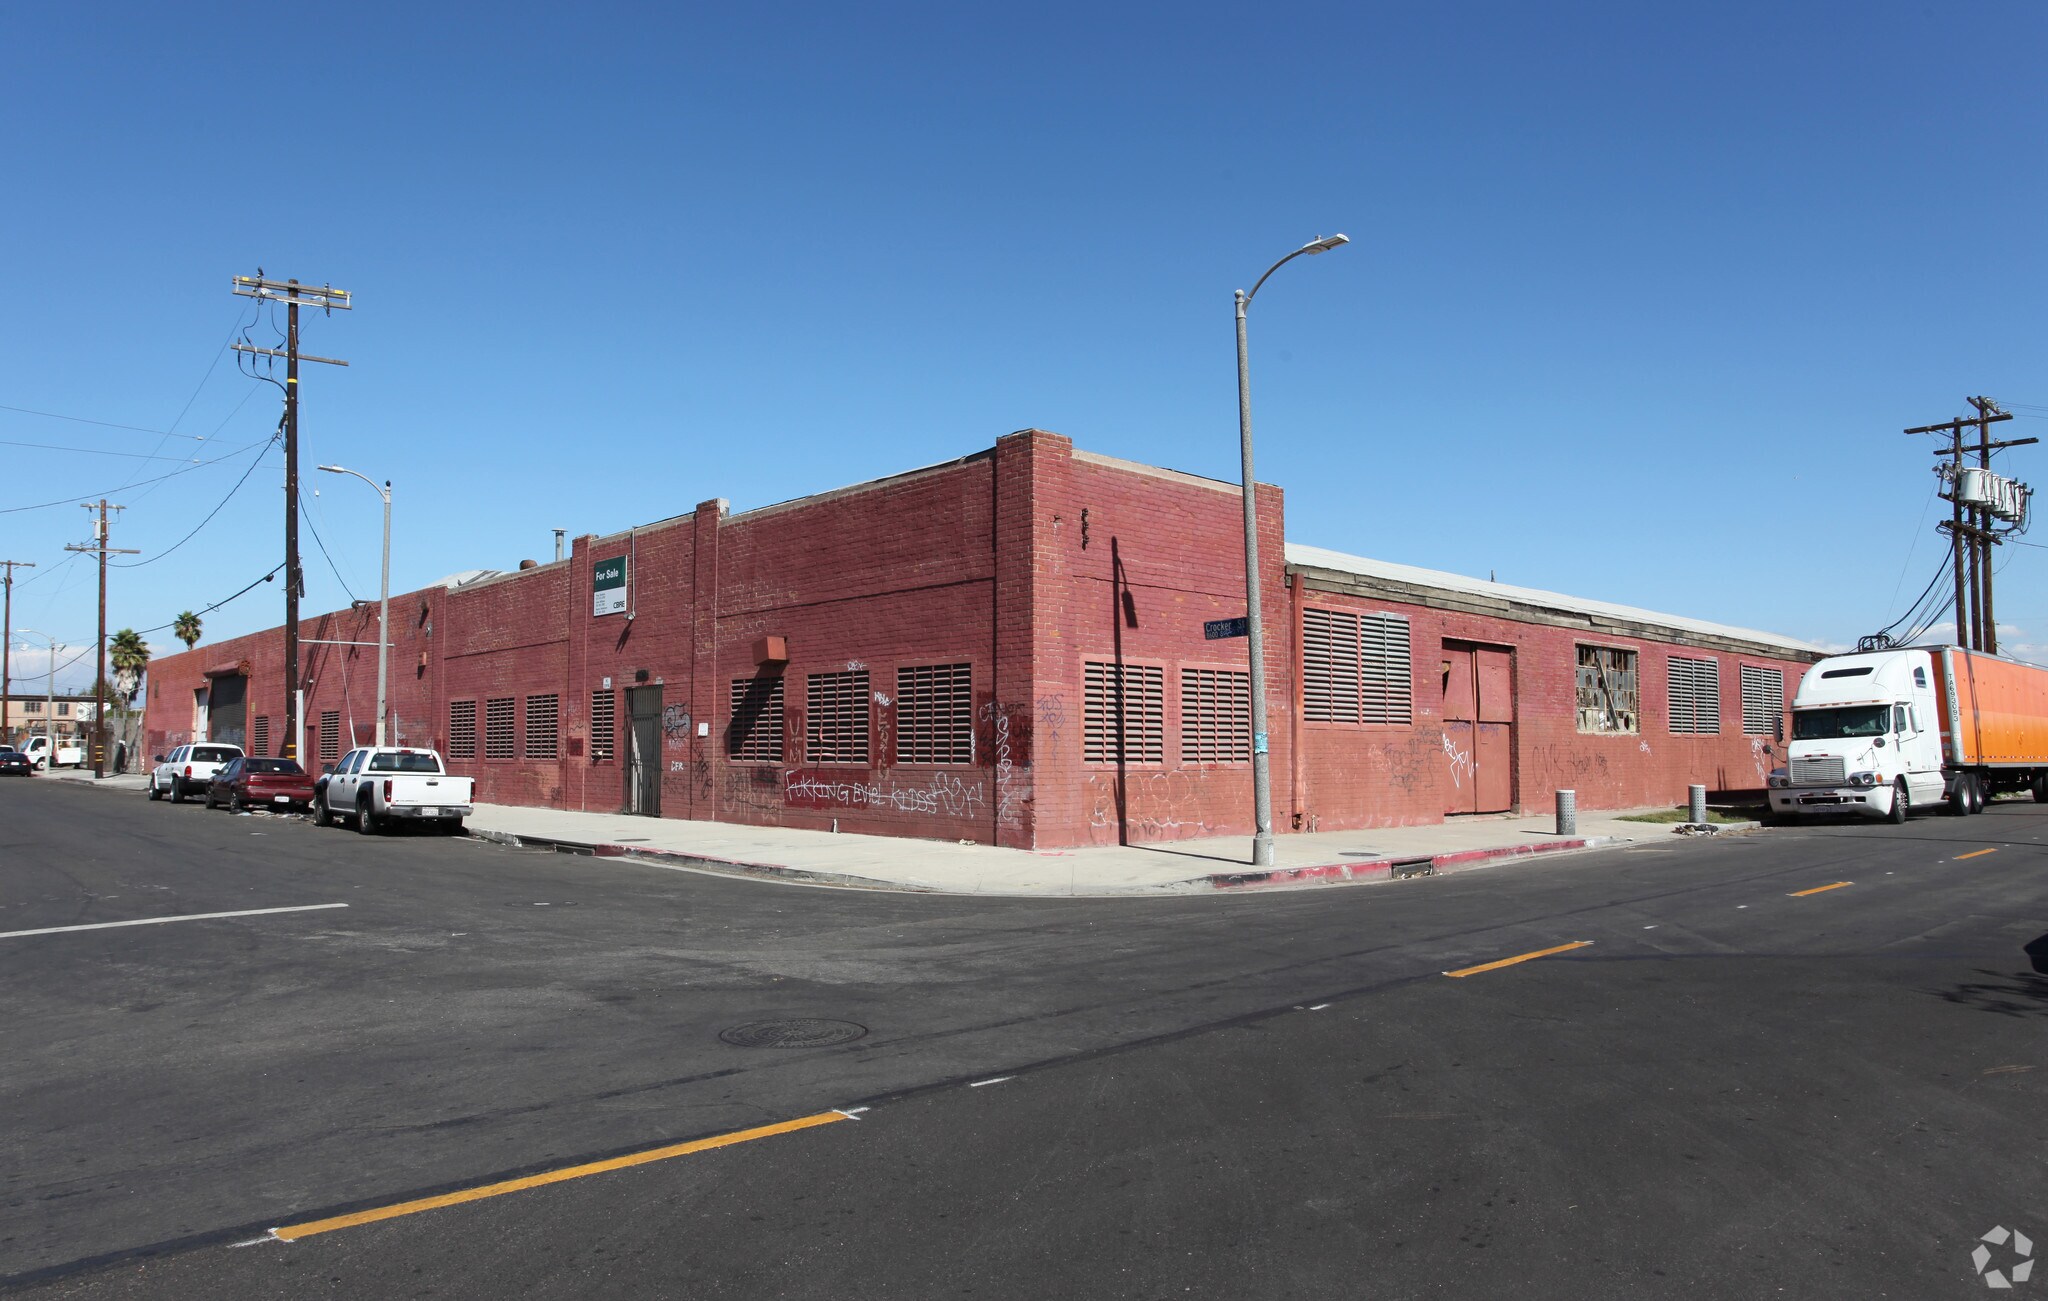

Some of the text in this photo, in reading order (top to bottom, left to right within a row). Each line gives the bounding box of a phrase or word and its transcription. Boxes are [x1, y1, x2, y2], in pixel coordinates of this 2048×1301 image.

[596, 568, 618, 581] For Sale
[613, 601, 625, 609] CBRE
[1205, 621, 1232, 632] Crocker
